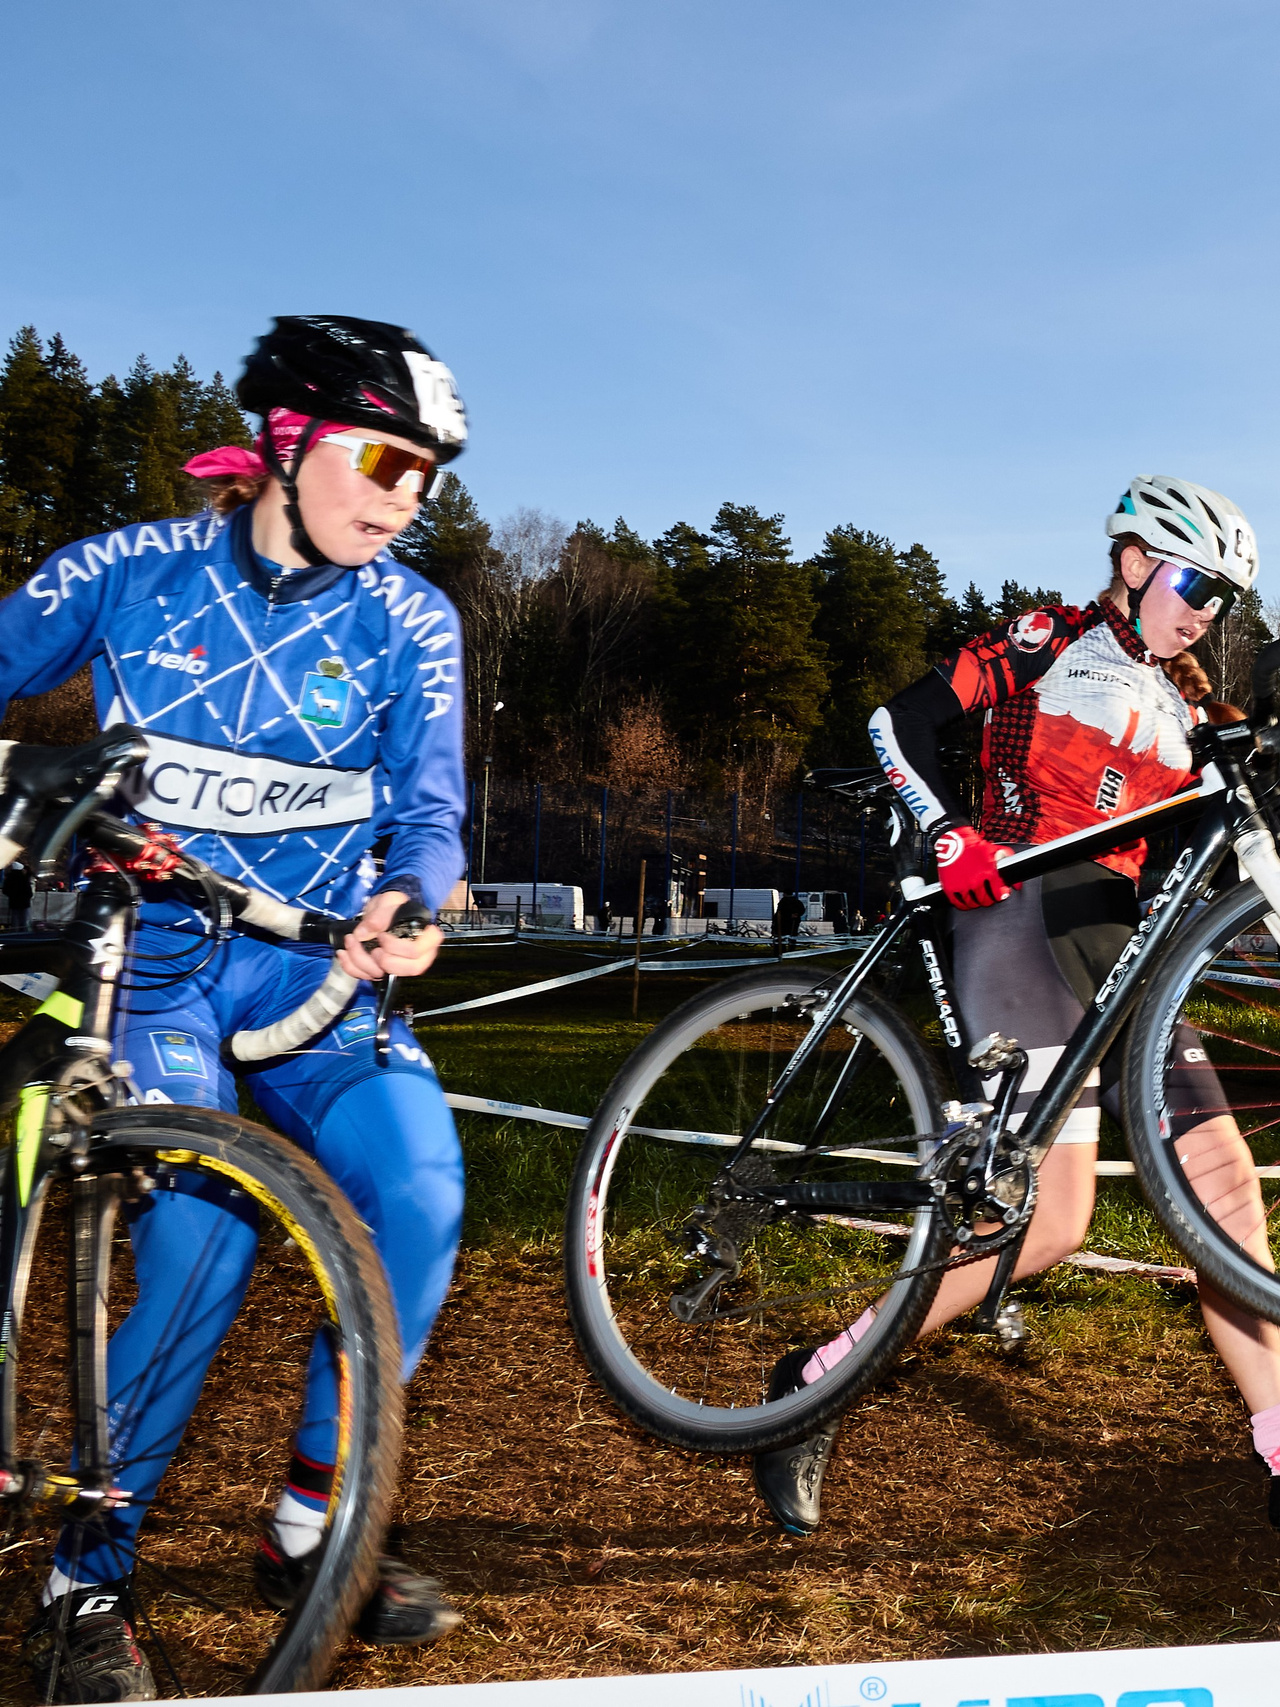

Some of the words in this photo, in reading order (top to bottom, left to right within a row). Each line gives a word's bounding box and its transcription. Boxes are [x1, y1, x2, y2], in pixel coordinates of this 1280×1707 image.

[147, 650, 209, 675] velo
[869, 728, 929, 818] КАТЮША
[1095, 847, 1194, 1012] FORWARD
[919, 938, 963, 1048] FORWARD
